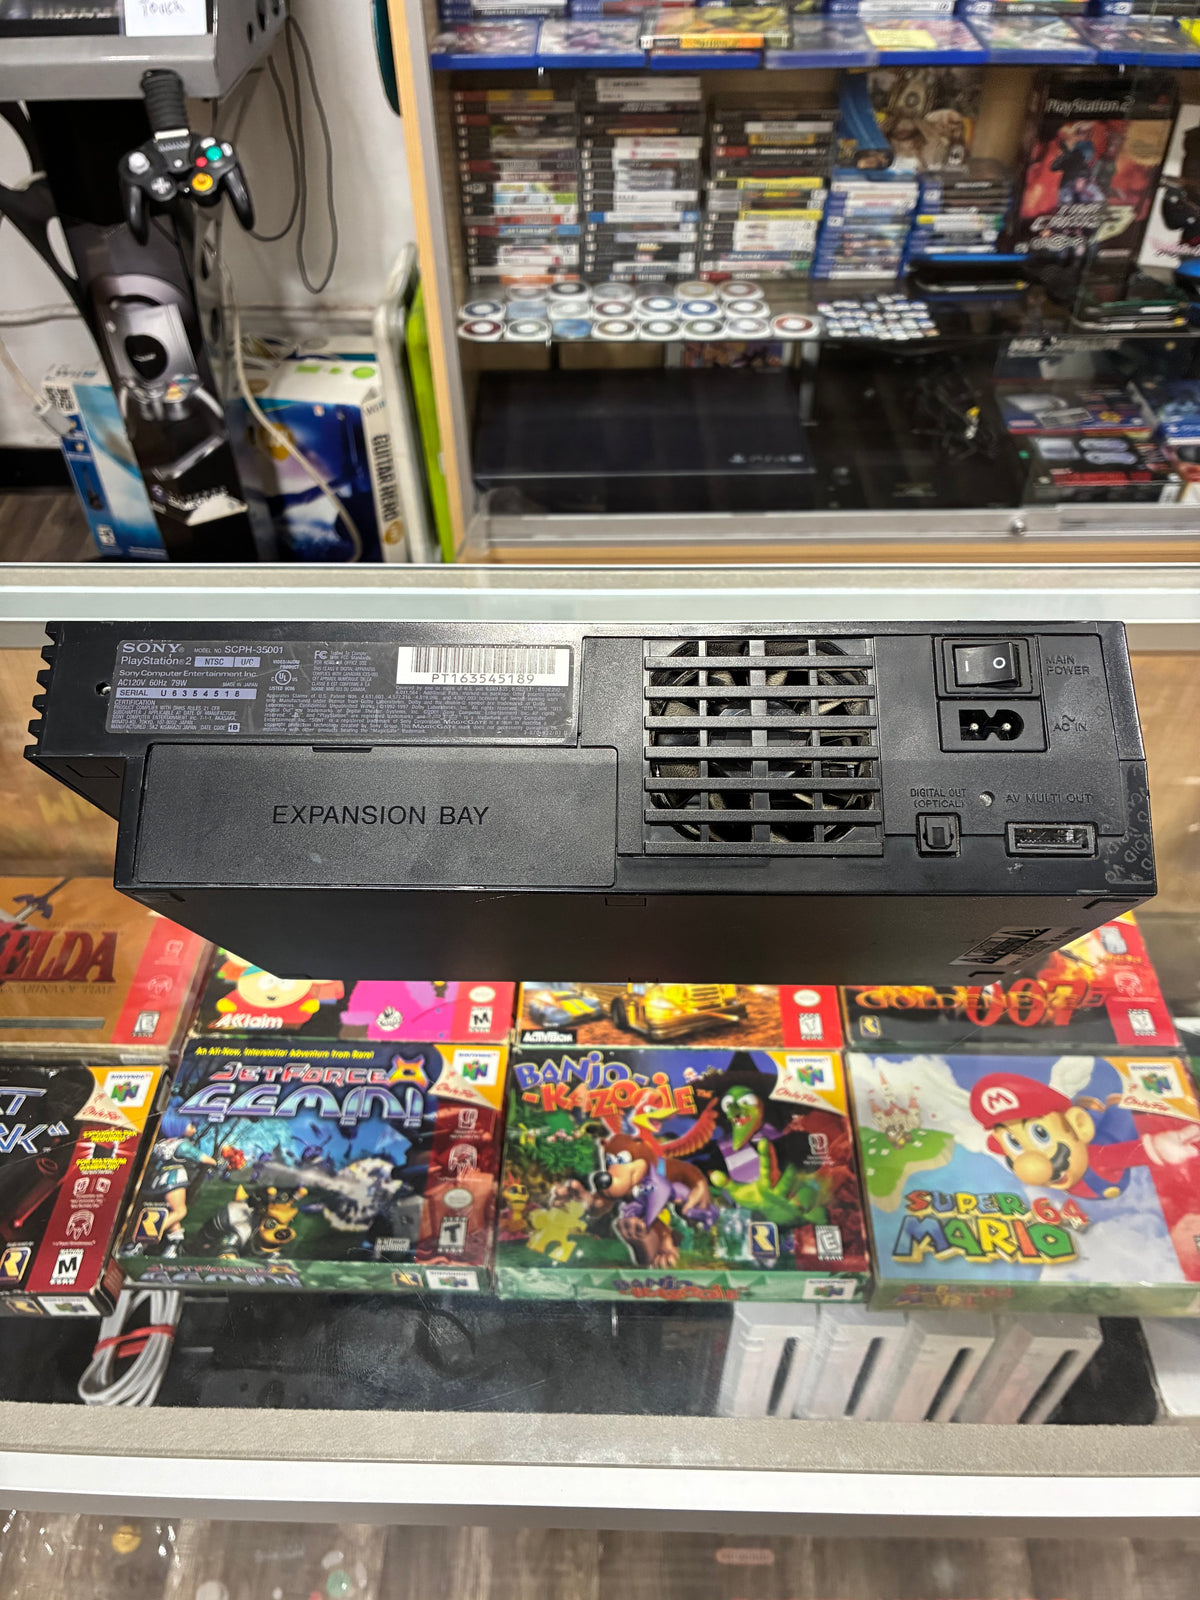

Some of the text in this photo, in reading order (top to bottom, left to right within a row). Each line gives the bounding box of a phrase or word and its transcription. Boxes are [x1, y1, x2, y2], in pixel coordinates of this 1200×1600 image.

[122, 642, 182, 653] SONY
[224, 646, 283, 654] SCPH-35001
[204, 658, 254, 666] NTSC U/C
[1046, 655, 1075, 665] MAIN
[119, 669, 141, 677] Sony
[1047, 666, 1090, 675] POWER
[117, 679, 146, 687] AC120V
[431, 673, 535, 684] PT163545189
[119, 689, 148, 697] SERIAL
[910, 788, 967, 798] DIGITAL OUT
[1005, 793, 1094, 803] AV MULTI OUT
[914, 799, 964, 809] (OPTICAL)
[272, 805, 490, 825] EXPANSION BAY
[0, 925, 118, 983] ELDA
[905, 1190, 1090, 1232] SUPER 64
[892, 1215, 1078, 1264] MARIO
[58, 1257, 78, 1274] M
